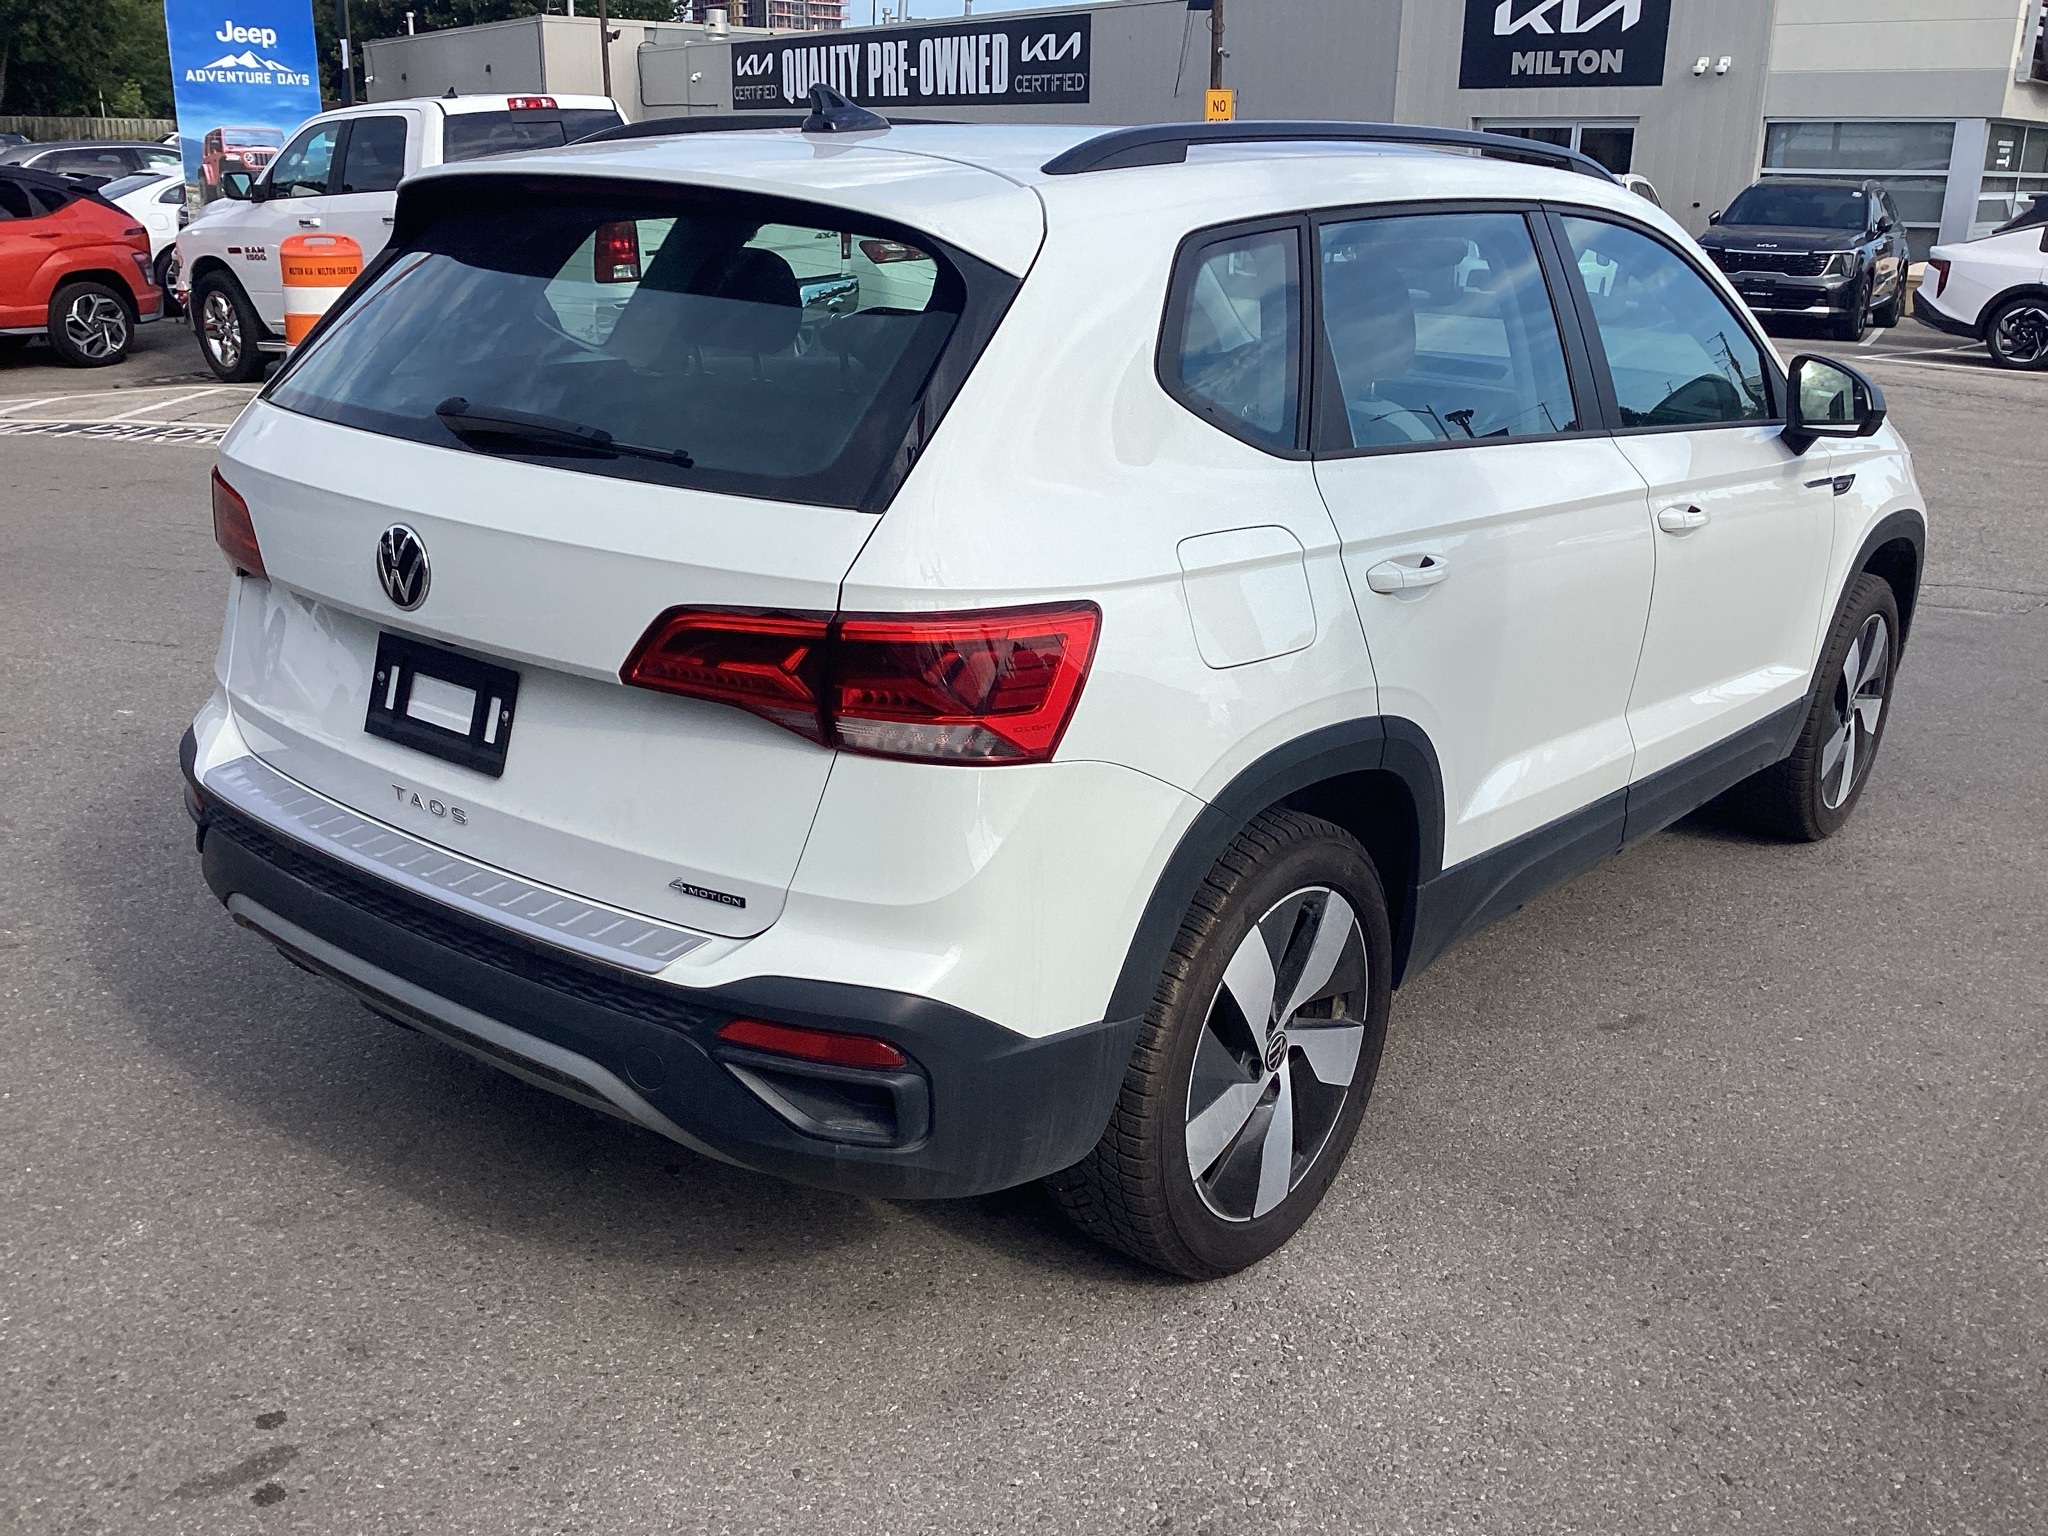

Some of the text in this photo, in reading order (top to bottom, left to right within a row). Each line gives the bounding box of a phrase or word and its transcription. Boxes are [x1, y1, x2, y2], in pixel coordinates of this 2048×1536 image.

[216, 20, 277, 48] Jeep
[1021, 32, 1081, 62] KIA
[736, 52, 774, 76] KIA
[782, 33, 1009, 105] QUALITY PRE-OWNED
[1511, 49, 1624, 75] MILTON
[185, 69, 310, 86] ADVENTURE DAYS
[1212, 99, 1227, 113] NO
[244, 246, 265, 254] RAM
[391, 783, 468, 826] TAOS
[669, 877, 742, 907] 4MOTION
